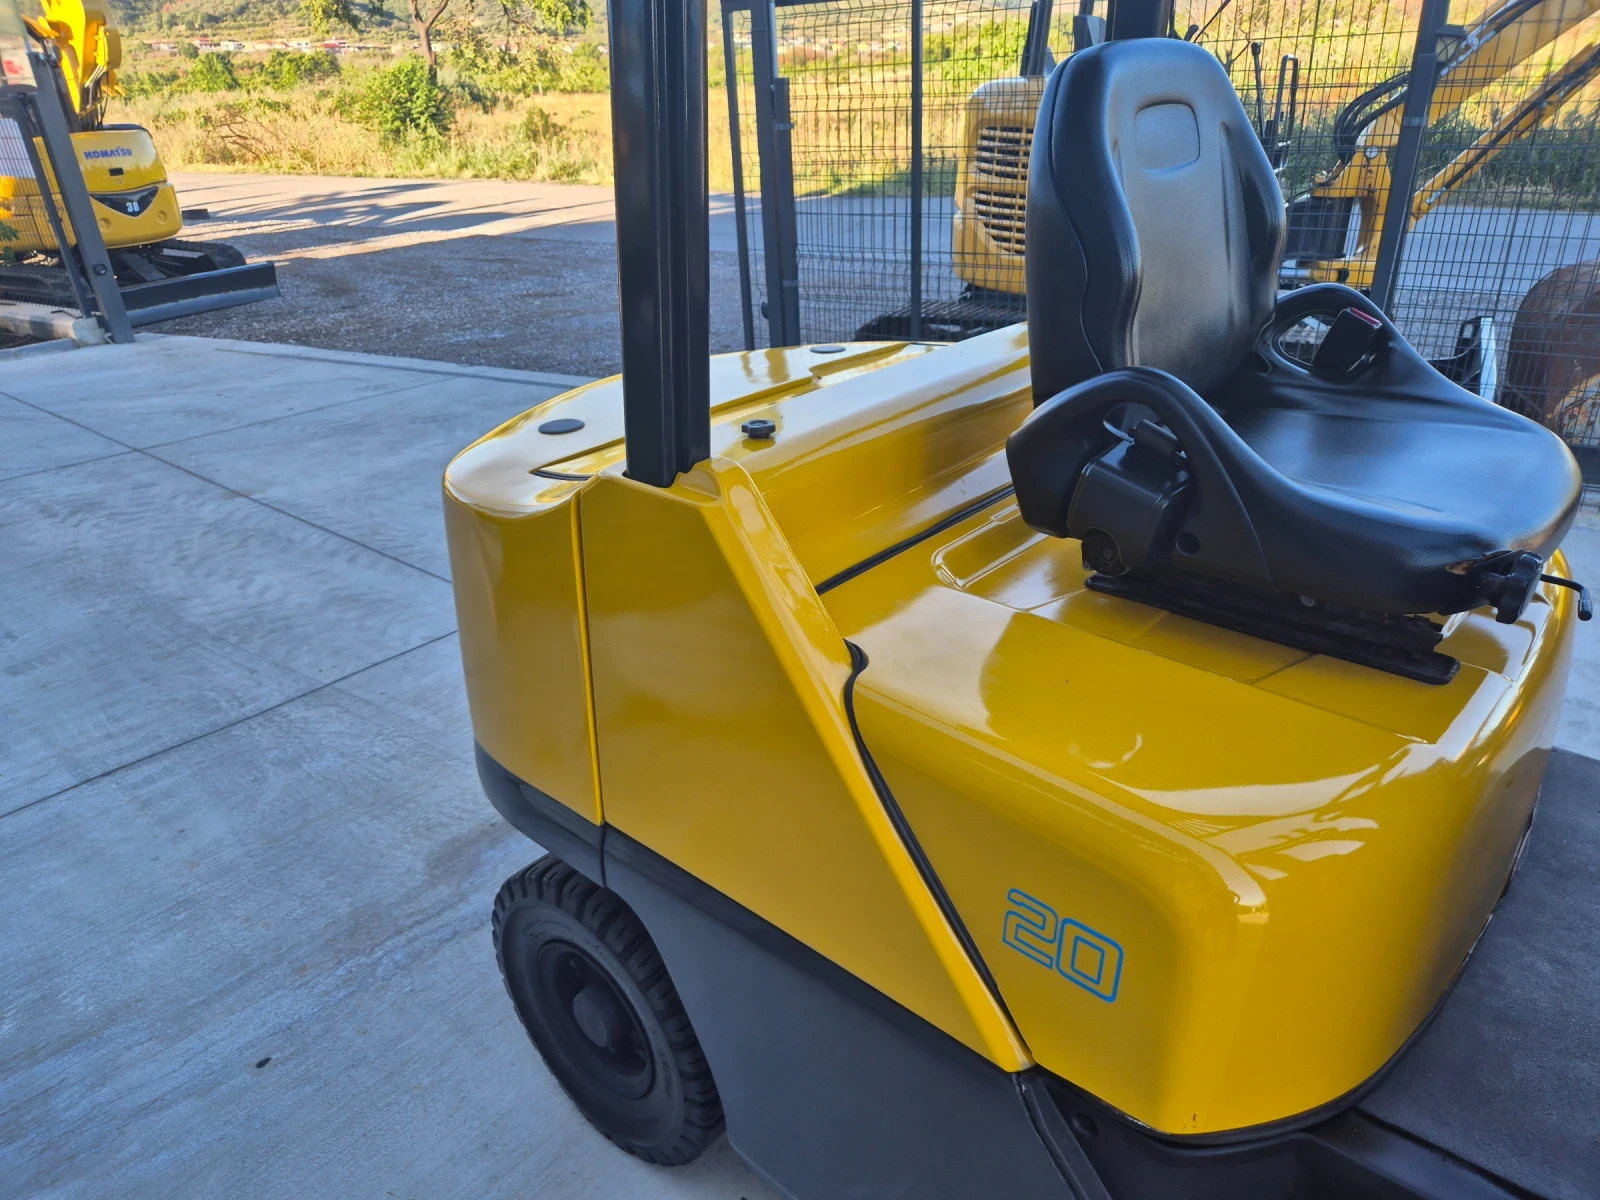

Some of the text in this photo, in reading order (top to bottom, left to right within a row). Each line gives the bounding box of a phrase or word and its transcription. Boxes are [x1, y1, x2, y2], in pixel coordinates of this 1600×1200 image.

[84, 147, 132, 160] KOMATSU
[126, 201, 140, 213] 38
[1002, 888, 1124, 1003] 20
